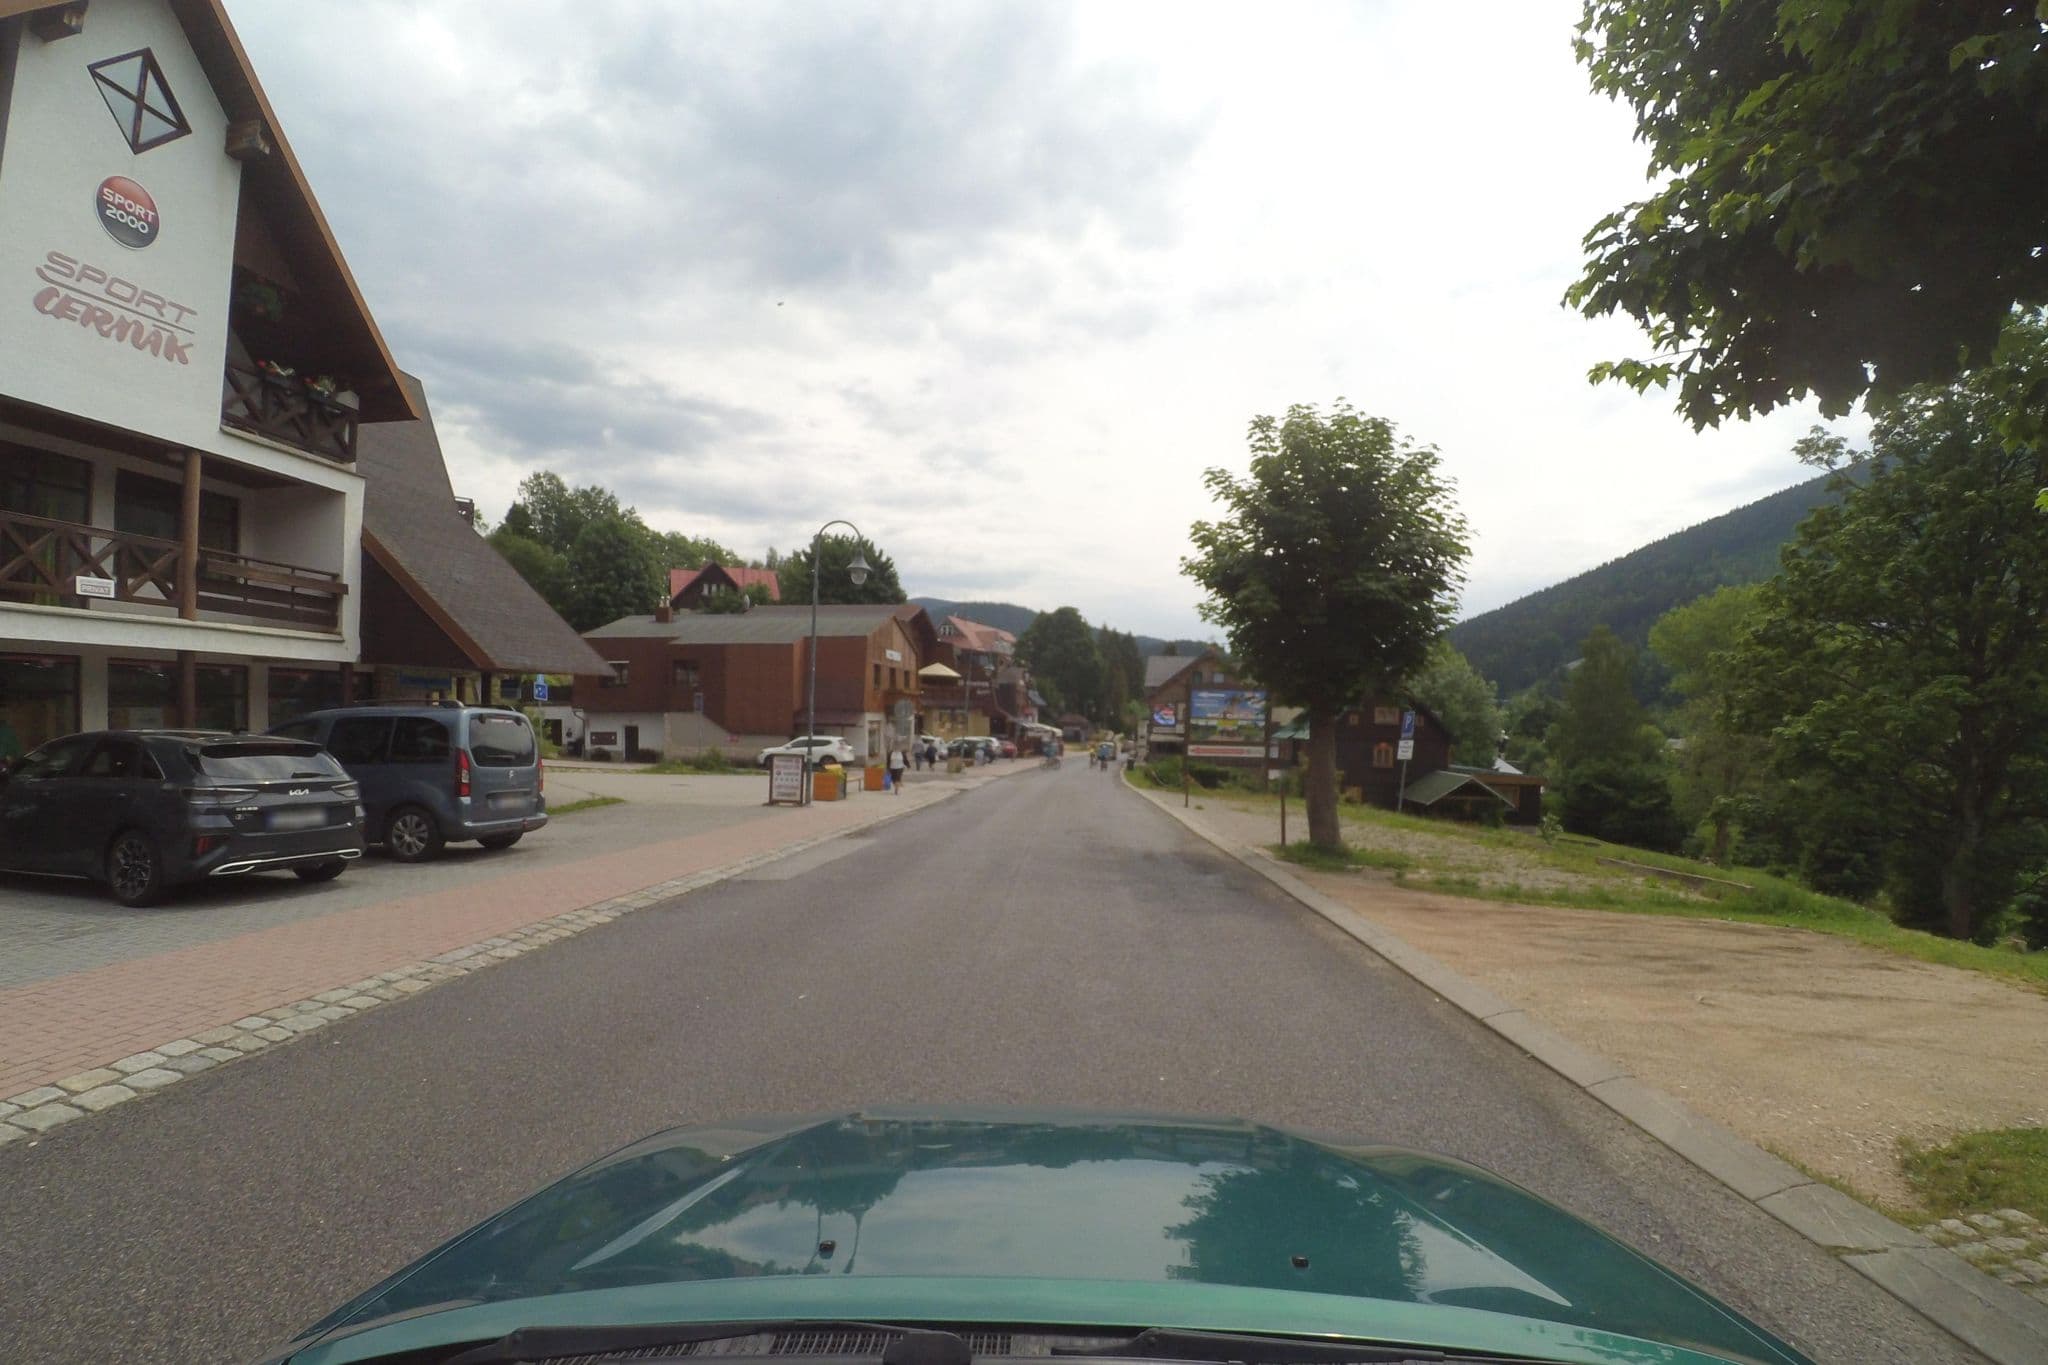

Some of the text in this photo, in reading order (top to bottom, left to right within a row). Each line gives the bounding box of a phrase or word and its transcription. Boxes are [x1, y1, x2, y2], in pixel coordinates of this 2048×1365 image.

[102, 187, 155, 222] SPORT
[105, 203, 149, 234] 2000
[43, 250, 198, 324] SPORT
[289, 788, 309, 796] KIA
